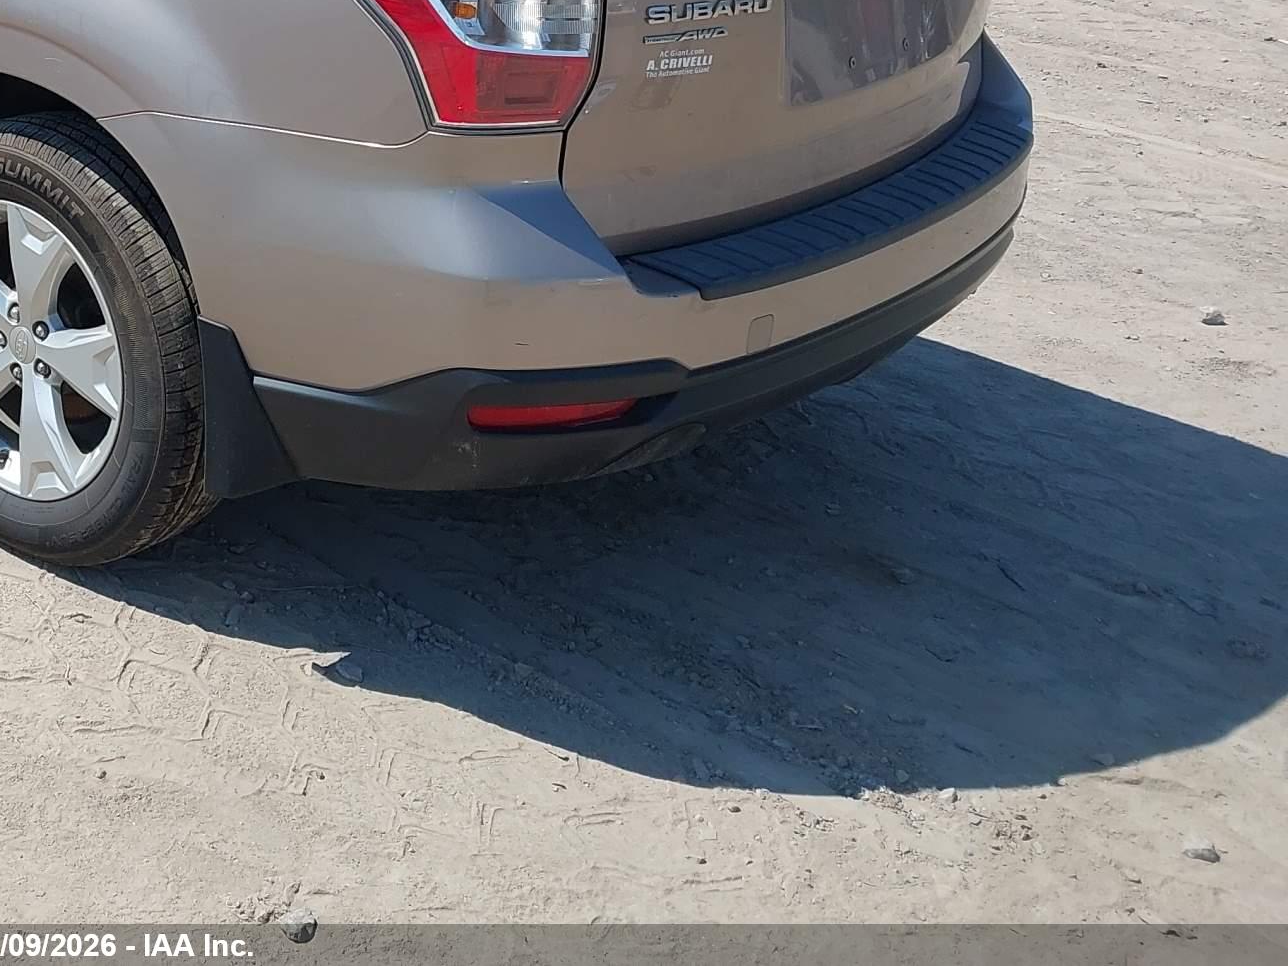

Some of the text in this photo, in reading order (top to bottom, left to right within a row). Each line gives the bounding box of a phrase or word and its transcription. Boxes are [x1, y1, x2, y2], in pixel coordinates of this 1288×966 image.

[676, 27, 728, 42] AWD
[646, 55, 713, 71] A. CRIVELLI
